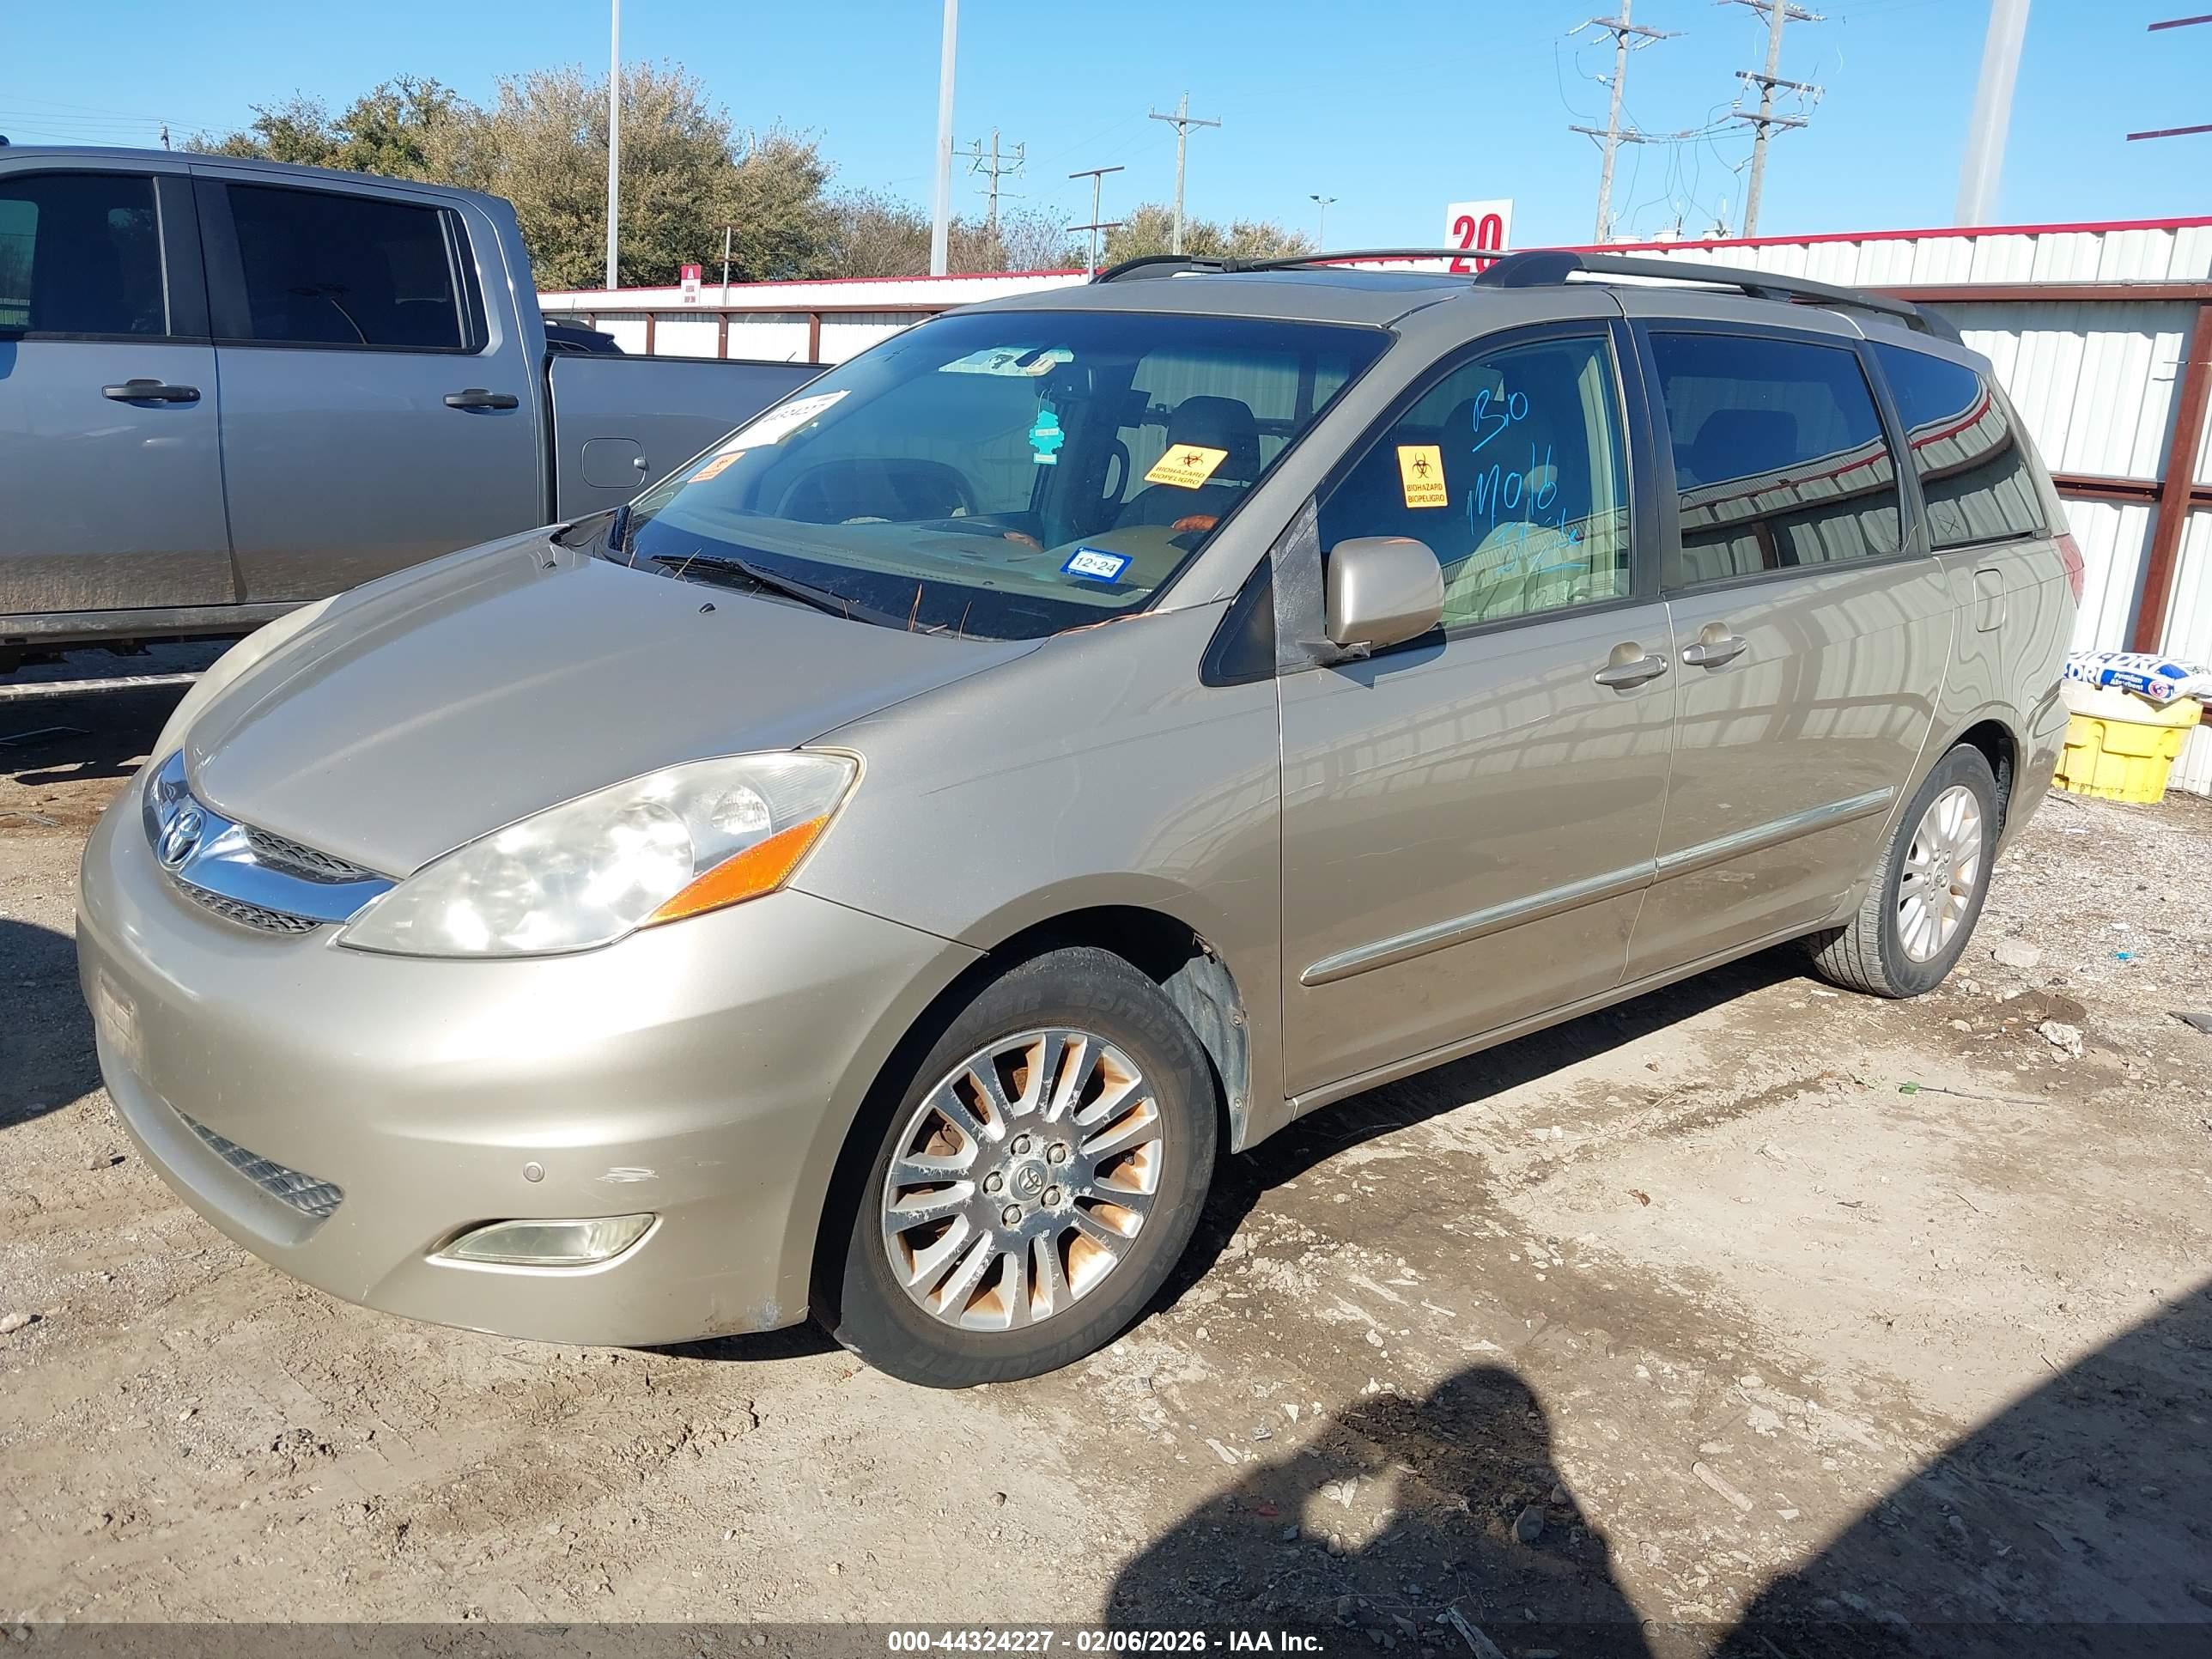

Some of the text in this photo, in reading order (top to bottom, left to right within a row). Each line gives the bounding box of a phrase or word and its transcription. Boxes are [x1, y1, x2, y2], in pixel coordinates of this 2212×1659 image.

[1449, 213, 1503, 273] 20
[1155, 466, 1206, 478] BIOHAZARD
[1149, 473, 1200, 485] BIOPELIGRO
[1407, 483, 1443, 492] BIOHAZARD
[1407, 494, 1445, 503] BIOPELIGRO
